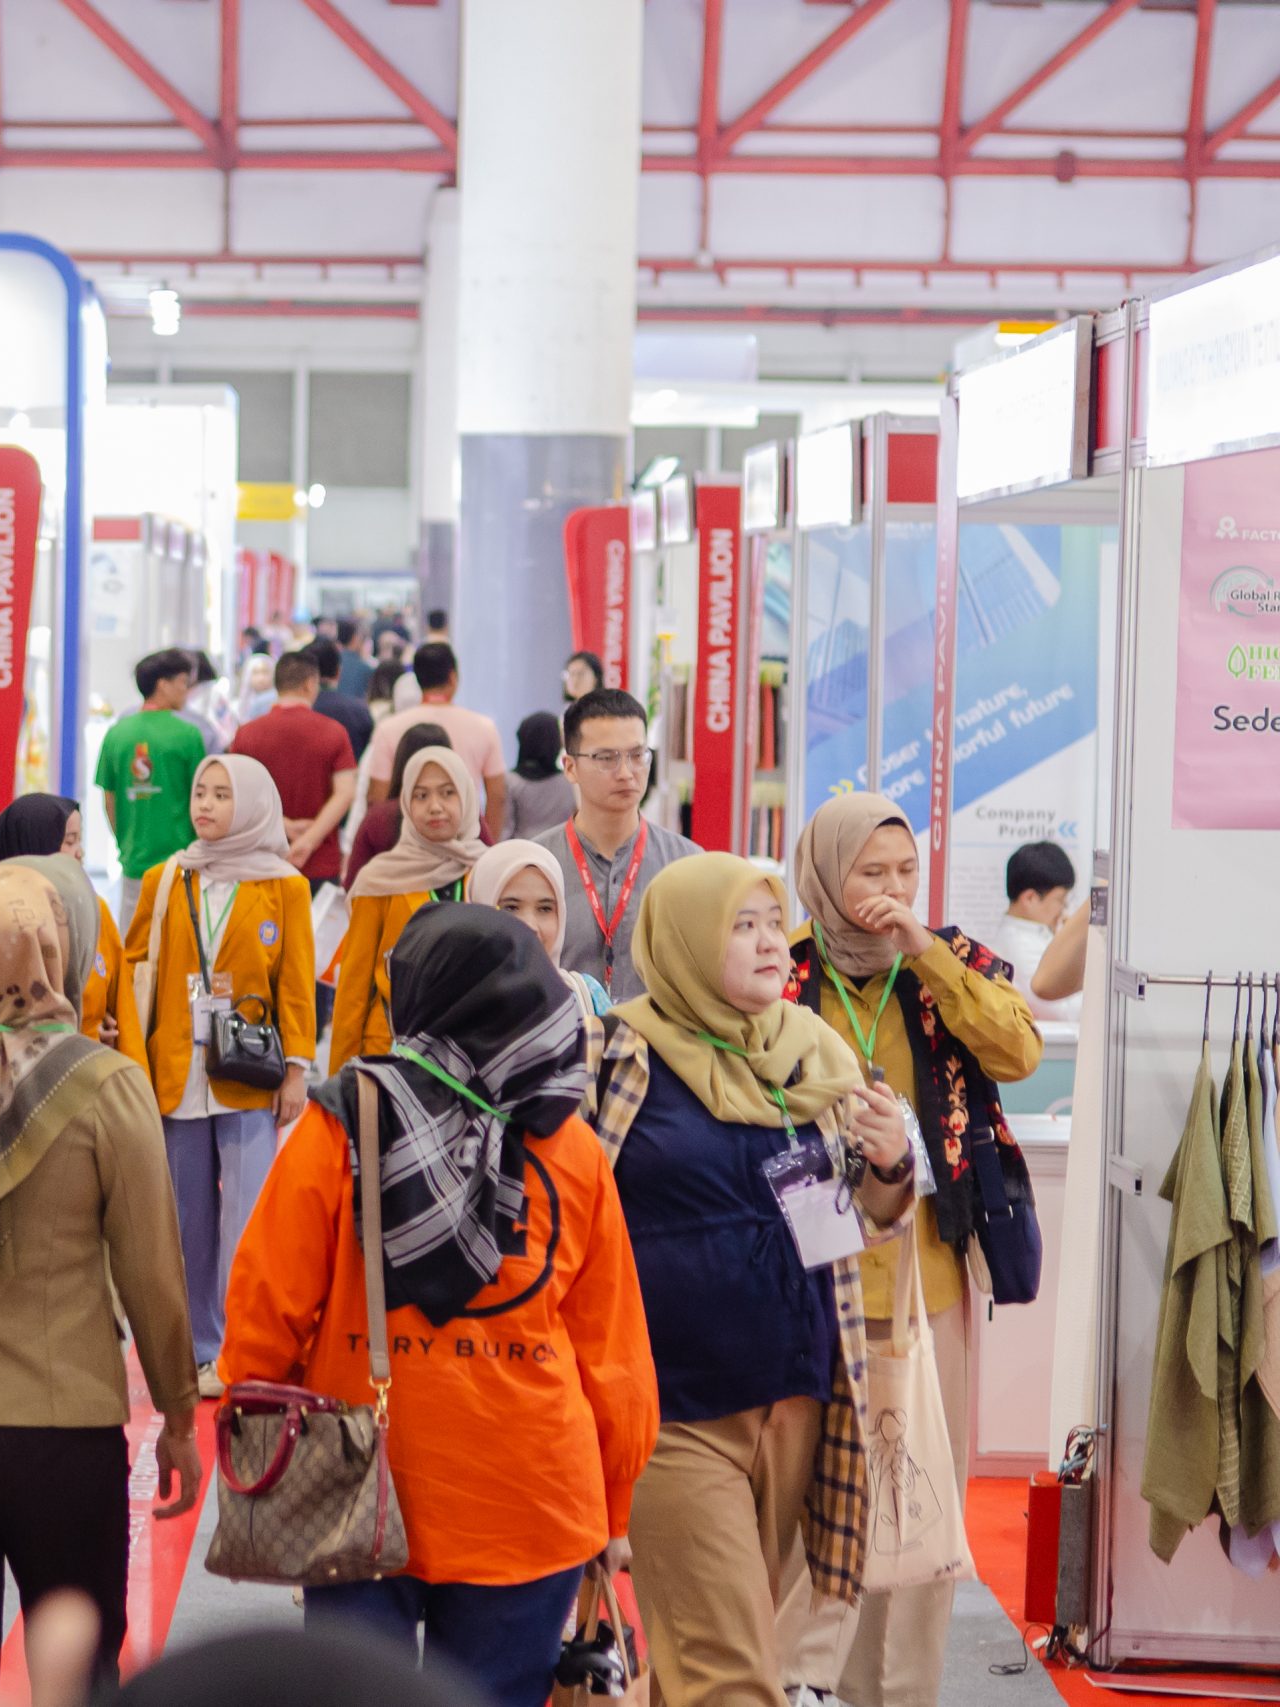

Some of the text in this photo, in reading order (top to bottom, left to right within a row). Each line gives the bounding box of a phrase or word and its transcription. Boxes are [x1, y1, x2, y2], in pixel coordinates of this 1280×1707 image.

[1230, 589, 1271, 601] Global
[603, 539, 626, 690] CHINA PAVILIO
[706, 528, 734, 733] CHINA PAVILION
[953, 718, 1006, 763] lorful
[1008, 684, 1074, 728] future
[857, 741, 920, 785] Coser
[976, 805, 1056, 823] Company
[999, 824, 1056, 838] Profile
[348, 1334, 434, 1355] TRY
